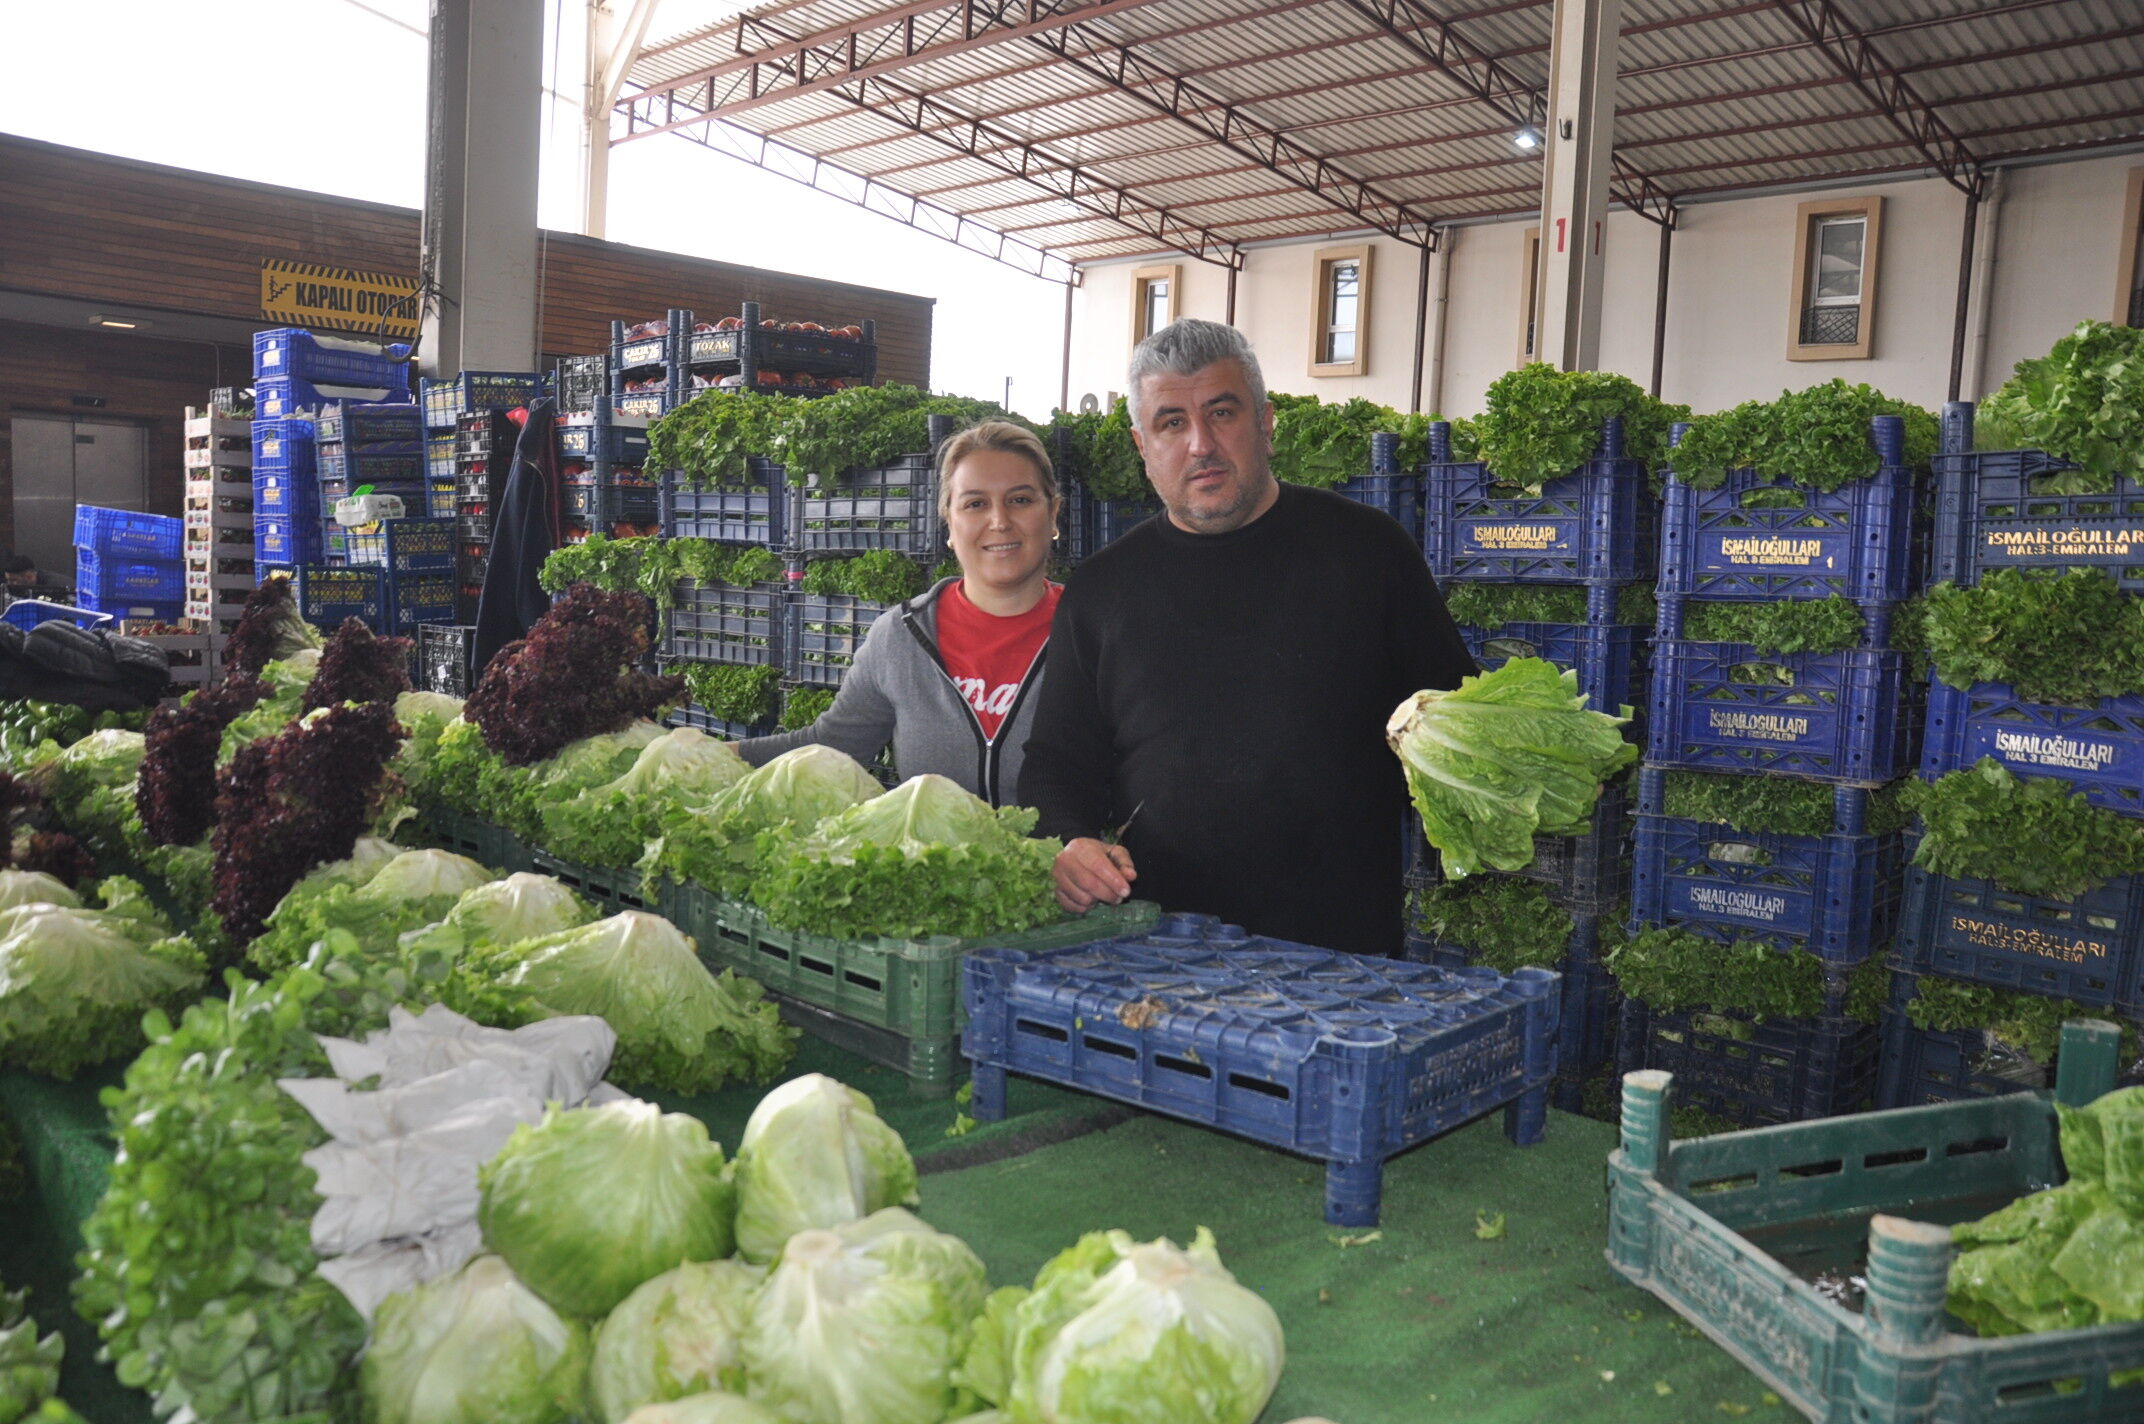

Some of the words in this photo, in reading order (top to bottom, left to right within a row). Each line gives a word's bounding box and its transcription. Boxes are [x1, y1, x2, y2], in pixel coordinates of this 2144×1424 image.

[1556, 217, 1566, 253] 1
[1595, 220, 1601, 256] 1
[295, 282, 353, 312] KAPALI
[573, 434, 585, 450] 26
[1722, 535, 1821, 557] İSMAİLOĞULLARI
[1731, 555, 1750, 564] HAL
[1751, 556, 1758, 564] 3
[1995, 728, 2114, 764] İSMAİLOĞULLARI
[2005, 751, 2028, 762] HAL
[2029, 753, 2038, 763] 3
[1698, 902, 1717, 912] HAL
[1718, 904, 1725, 913] 3
[1952, 916, 2106, 958] İSMAİLOĞULLARI
